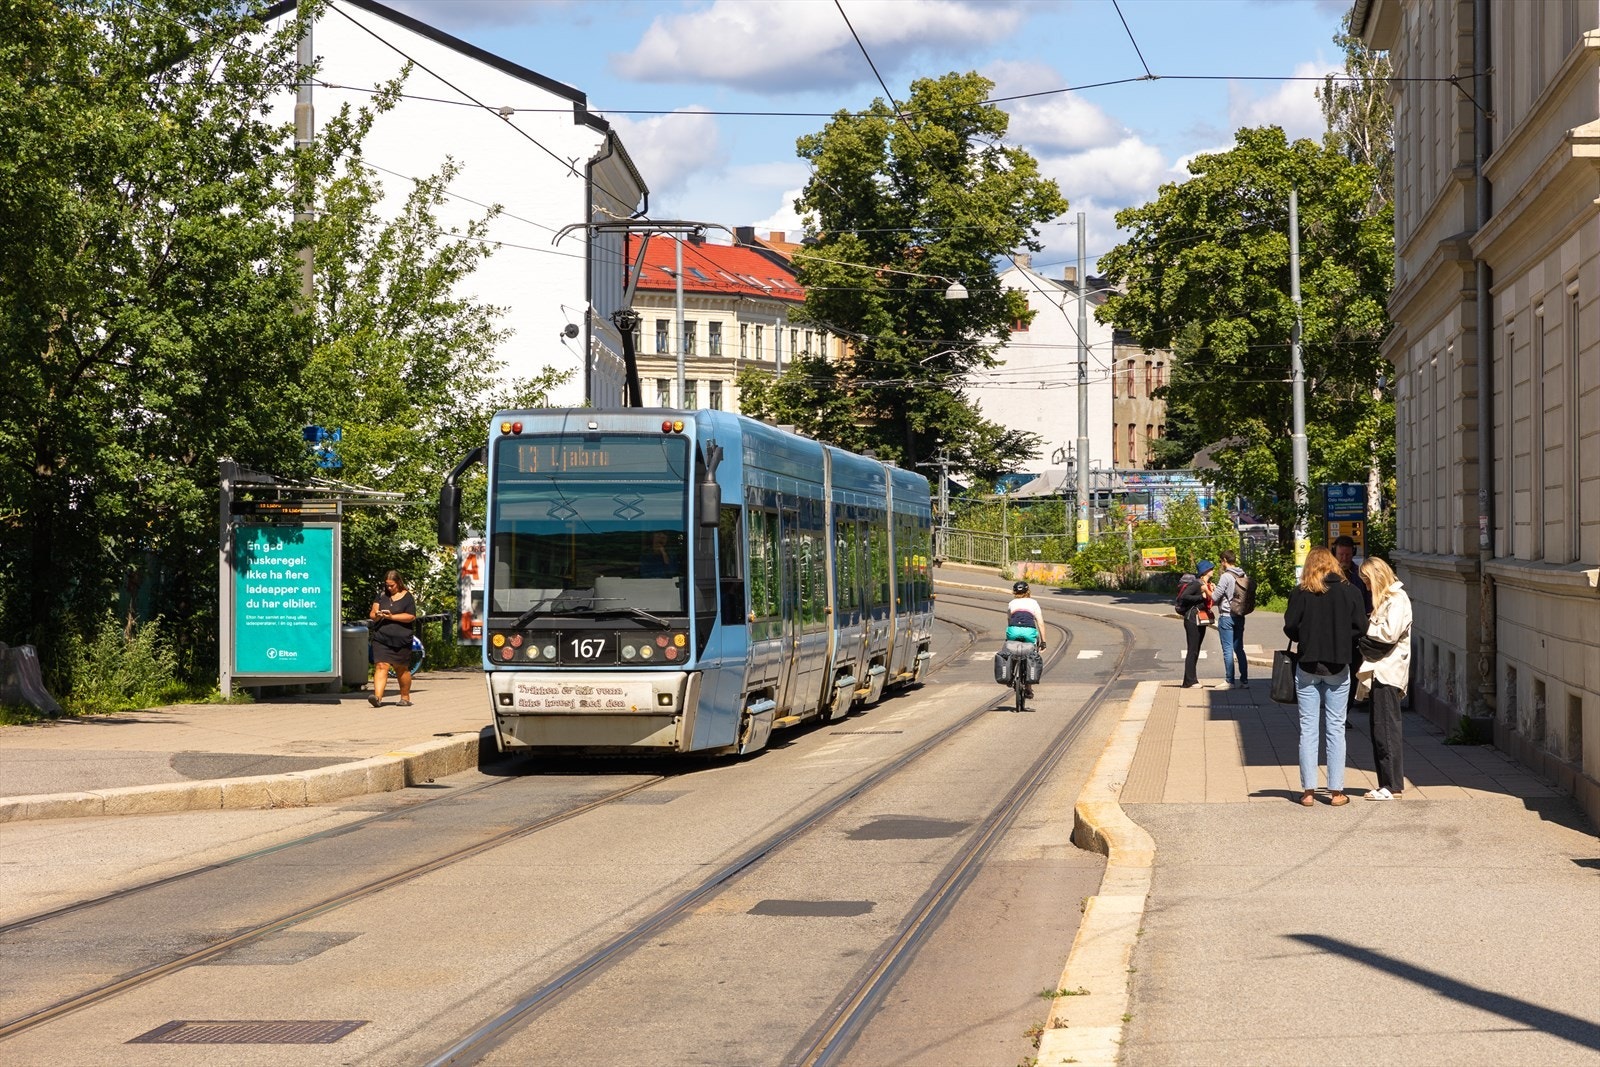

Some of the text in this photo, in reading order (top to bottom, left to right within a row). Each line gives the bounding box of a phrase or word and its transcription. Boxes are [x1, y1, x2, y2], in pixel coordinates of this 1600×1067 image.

[551, 446, 610, 472] Ljabru
[263, 541, 283, 552] god
[247, 556, 307, 567] huskeregel:
[246, 570, 309, 579] Ikke ha flere
[246, 584, 299, 596] ladeapper
[246, 599, 317, 608] du har elbiler.
[571, 639, 605, 658] 167
[518, 684, 559, 695] Trikken
[562, 686, 573, 695] er
[519, 698, 541, 707] ikke
[606, 699, 626, 707] den
